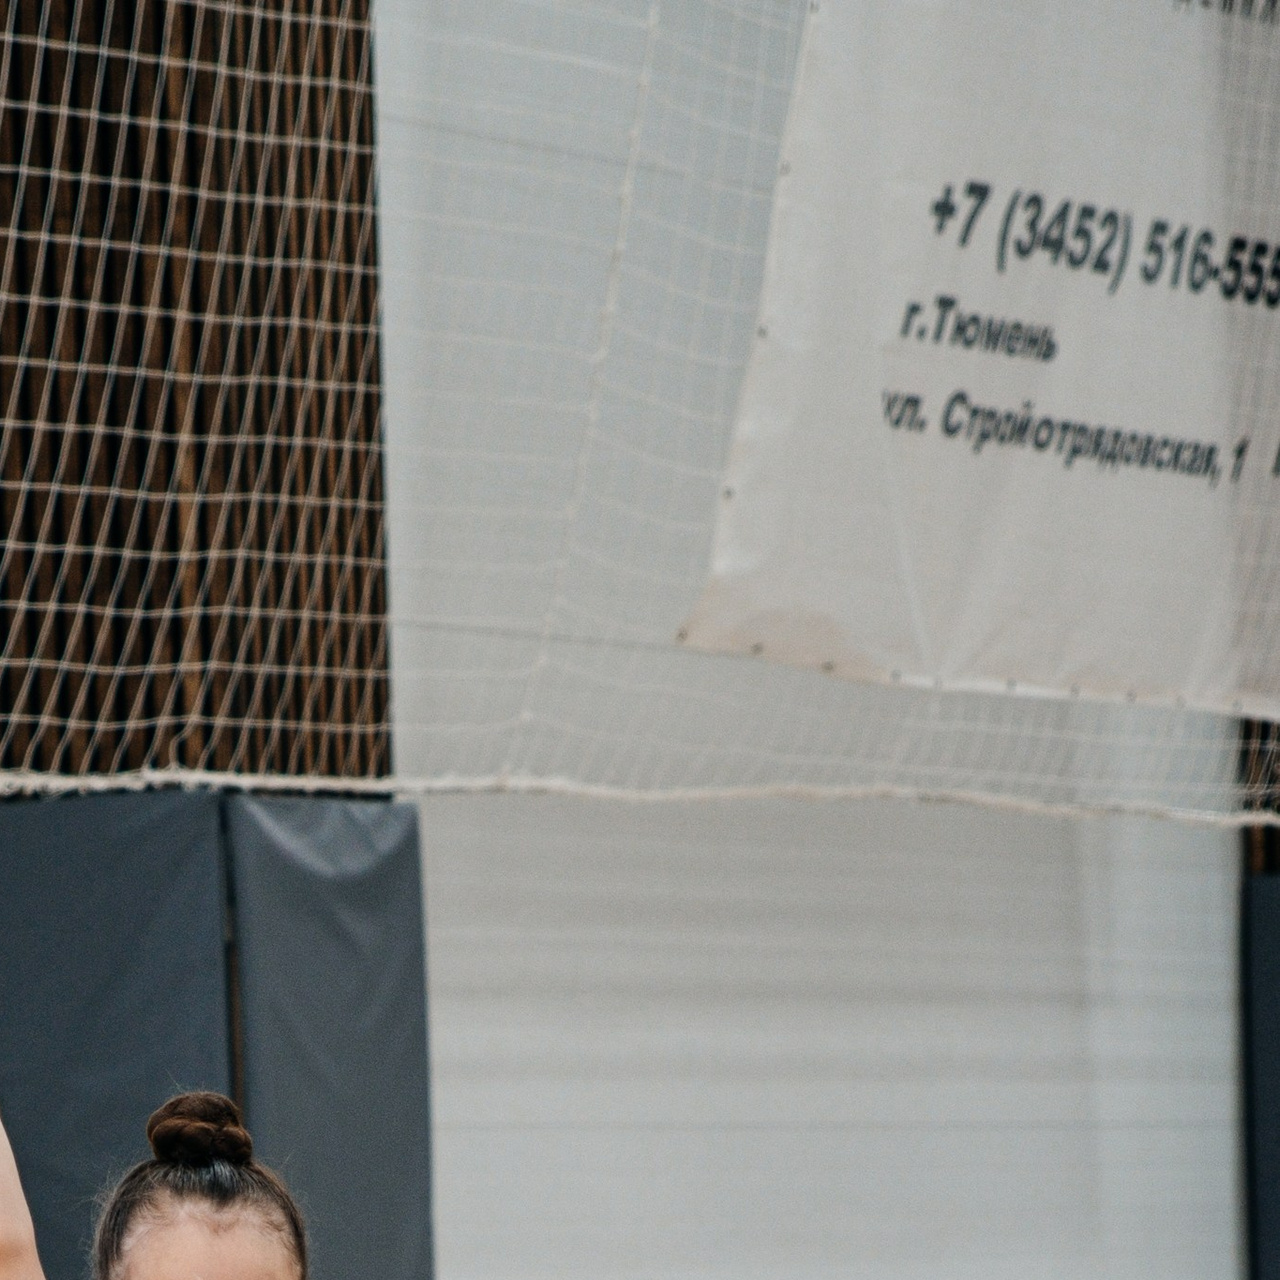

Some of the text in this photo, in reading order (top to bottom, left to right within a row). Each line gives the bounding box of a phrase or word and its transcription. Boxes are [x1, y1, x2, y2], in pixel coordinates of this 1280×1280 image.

[929, 181, 991, 248] +7
[996, 189, 1133, 295] (3452)
[900, 295, 1057, 361] г.Тюмень
[1230, 435, 1251, 484] 1
